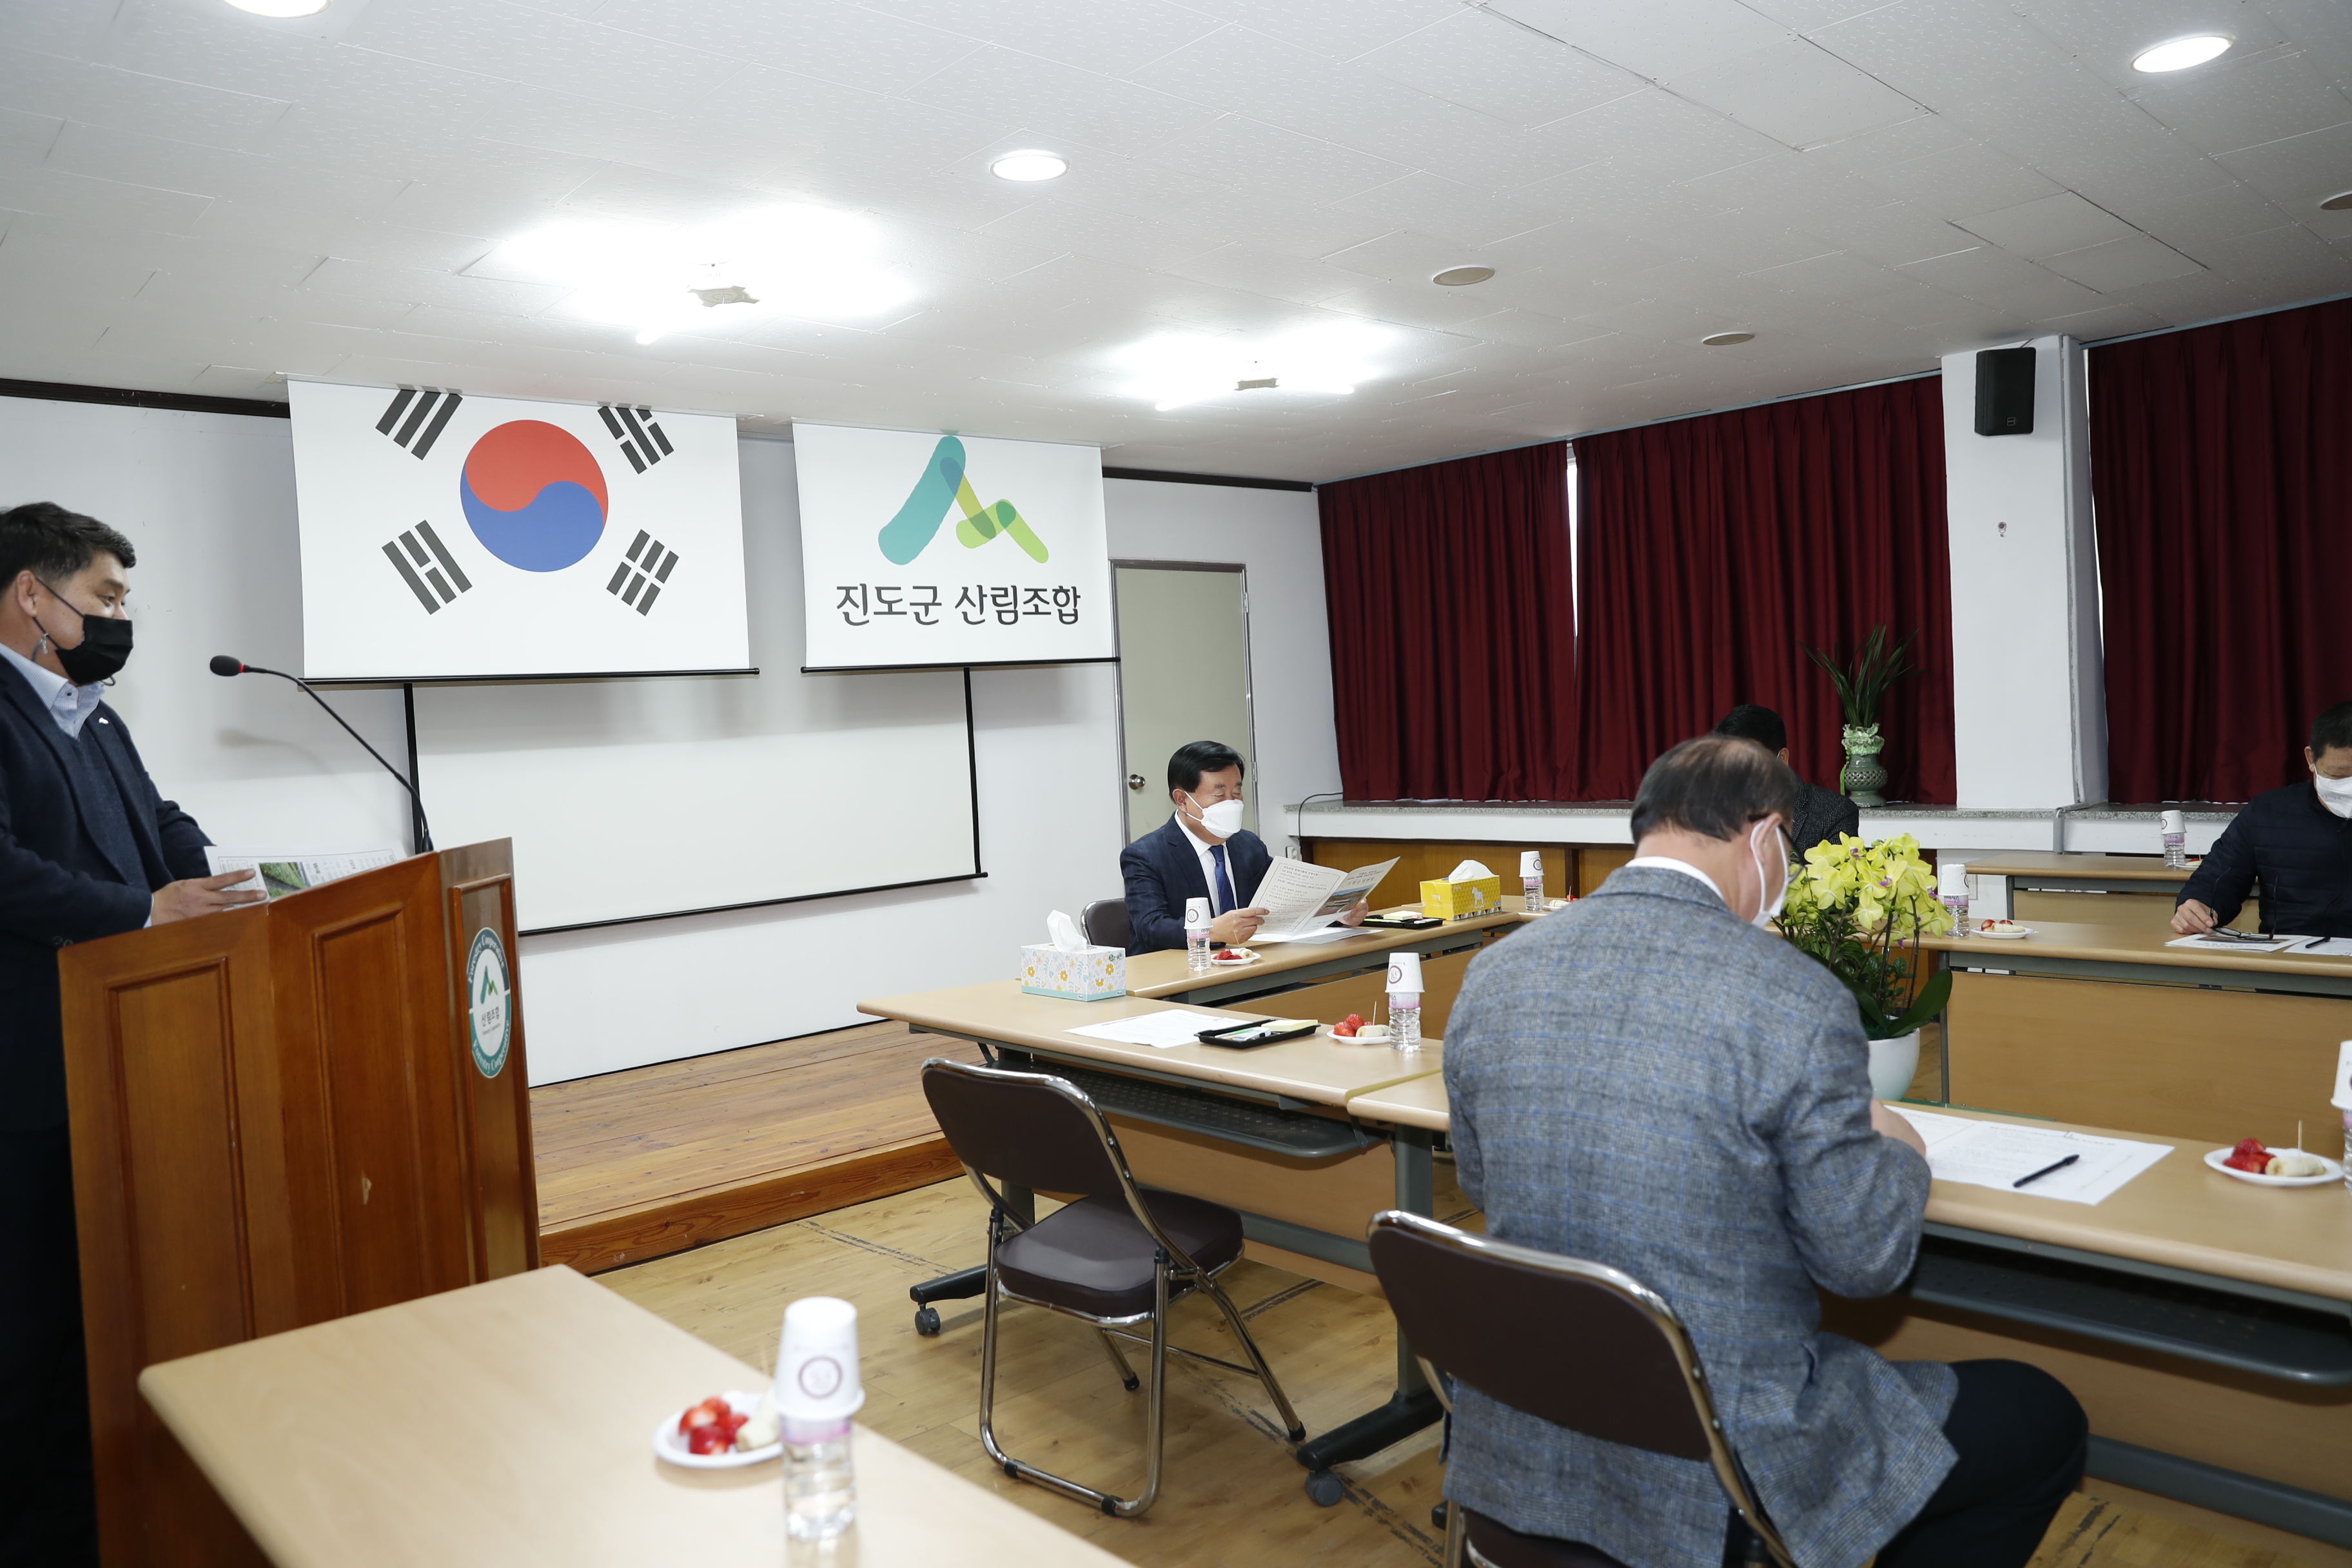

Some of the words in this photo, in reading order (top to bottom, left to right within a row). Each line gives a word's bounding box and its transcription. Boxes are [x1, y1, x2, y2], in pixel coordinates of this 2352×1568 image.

[836, 583, 943, 626] 진도군
[954, 584, 1081, 625] 산림조합
[482, 1006, 500, 1027] 산림조합
